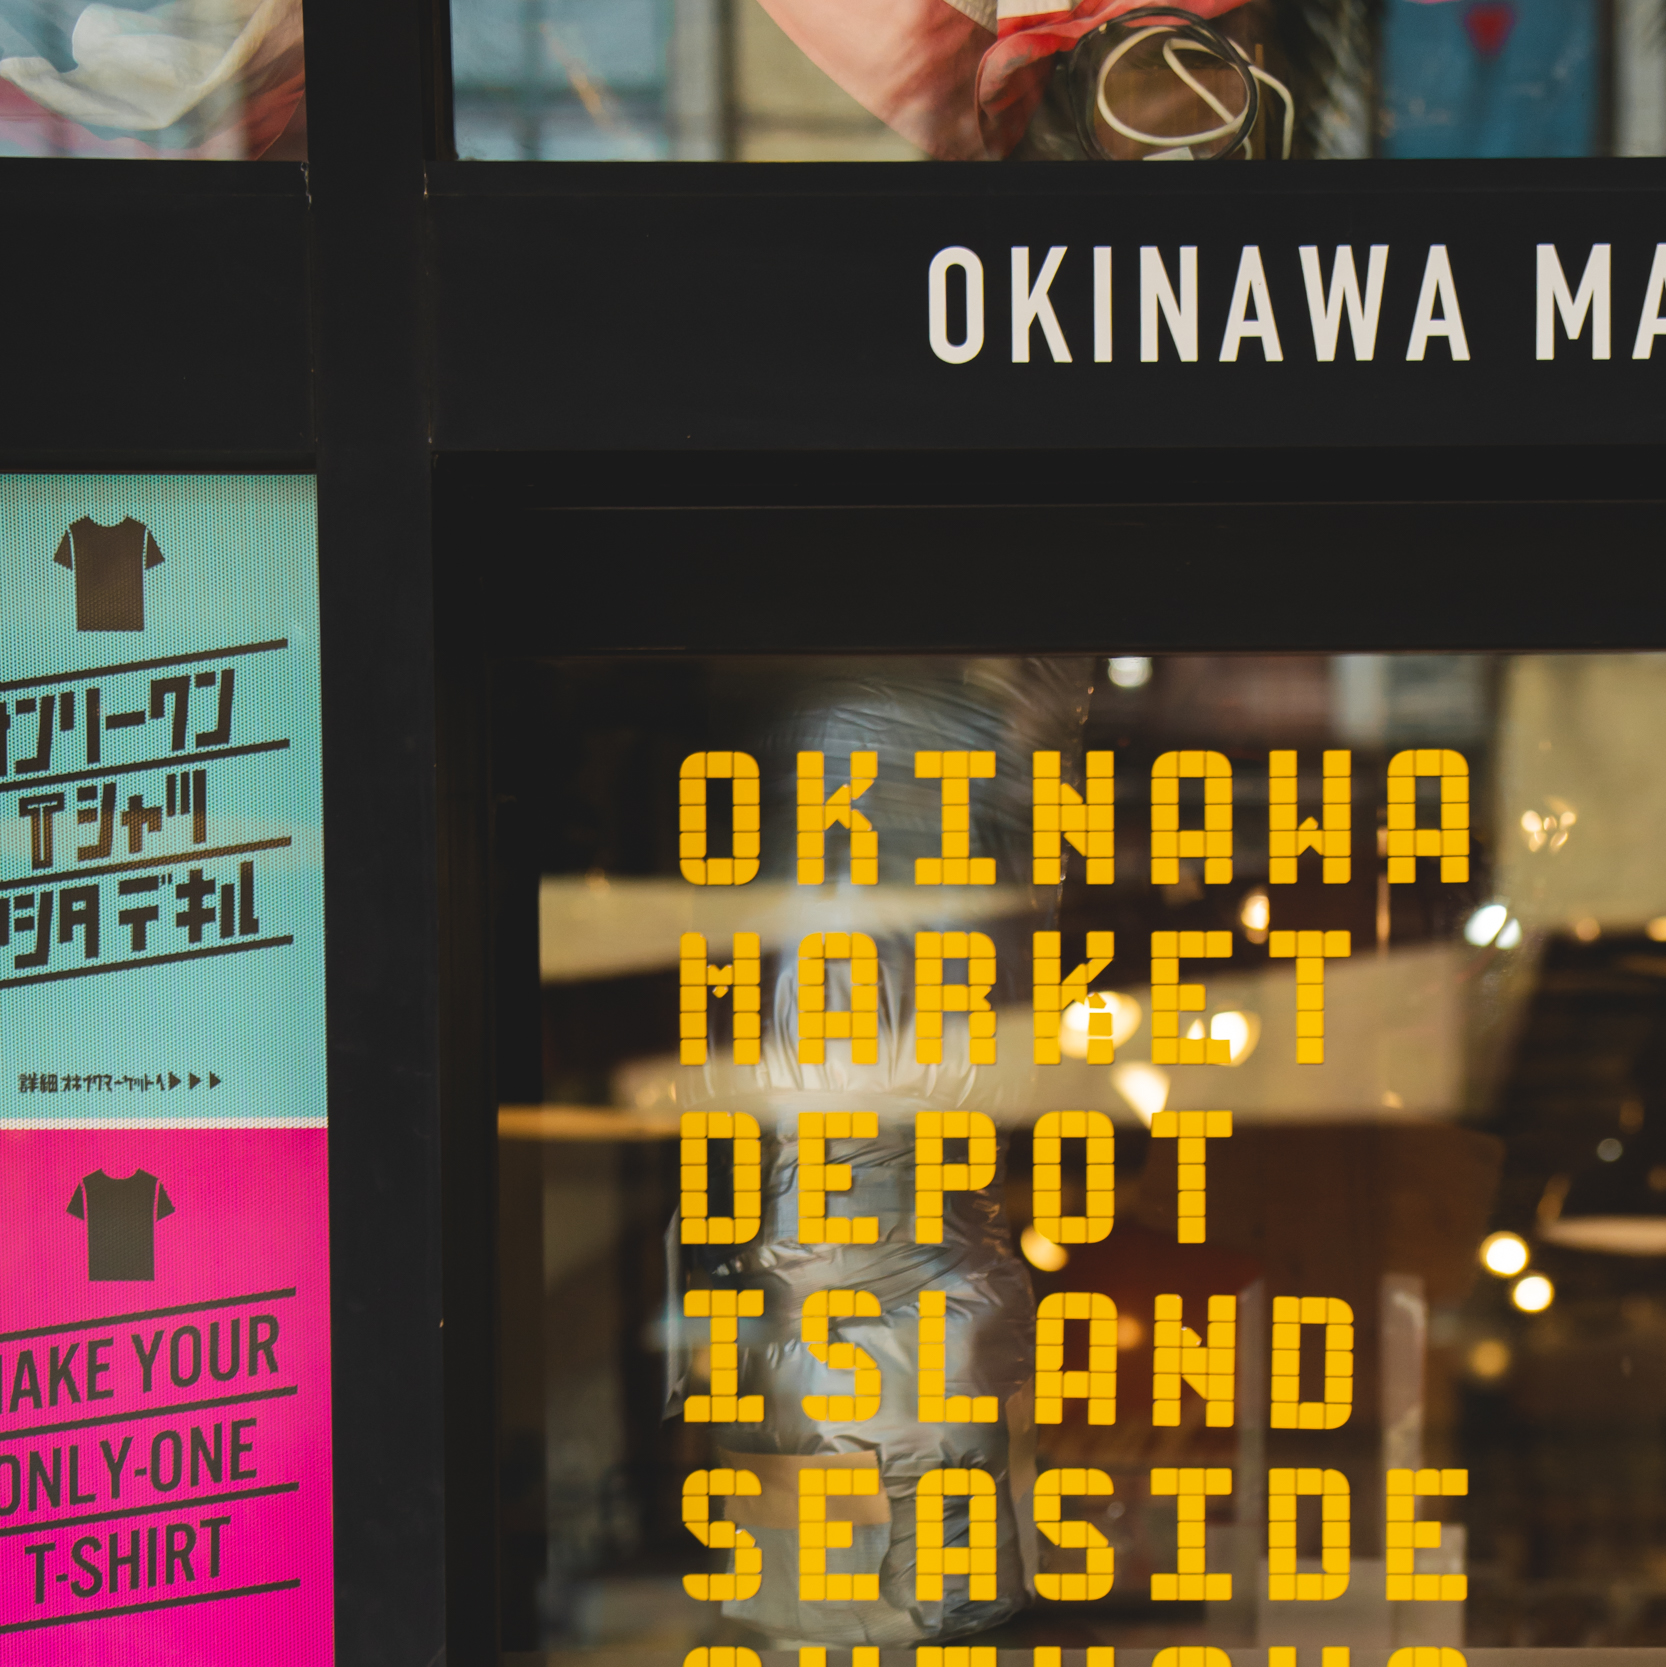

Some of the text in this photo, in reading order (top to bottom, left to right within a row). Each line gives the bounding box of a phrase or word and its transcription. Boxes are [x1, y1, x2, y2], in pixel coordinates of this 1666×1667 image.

[928, 245, 1470, 364] OKINAWA
[0, 669, 235, 777] ンリーワン
[680, 750, 1470, 886] OKINAWA
[680, 930, 1351, 1066] MARKET
[680, 1110, 1233, 1245] DEPOT
[0, 1314, 280, 1415] AKE YOUR
[683, 1289, 1354, 1430] ISLAND
[24, 1515, 232, 1605] T-SHIRT
[682, 1468, 1469, 1602] SEASIDE
